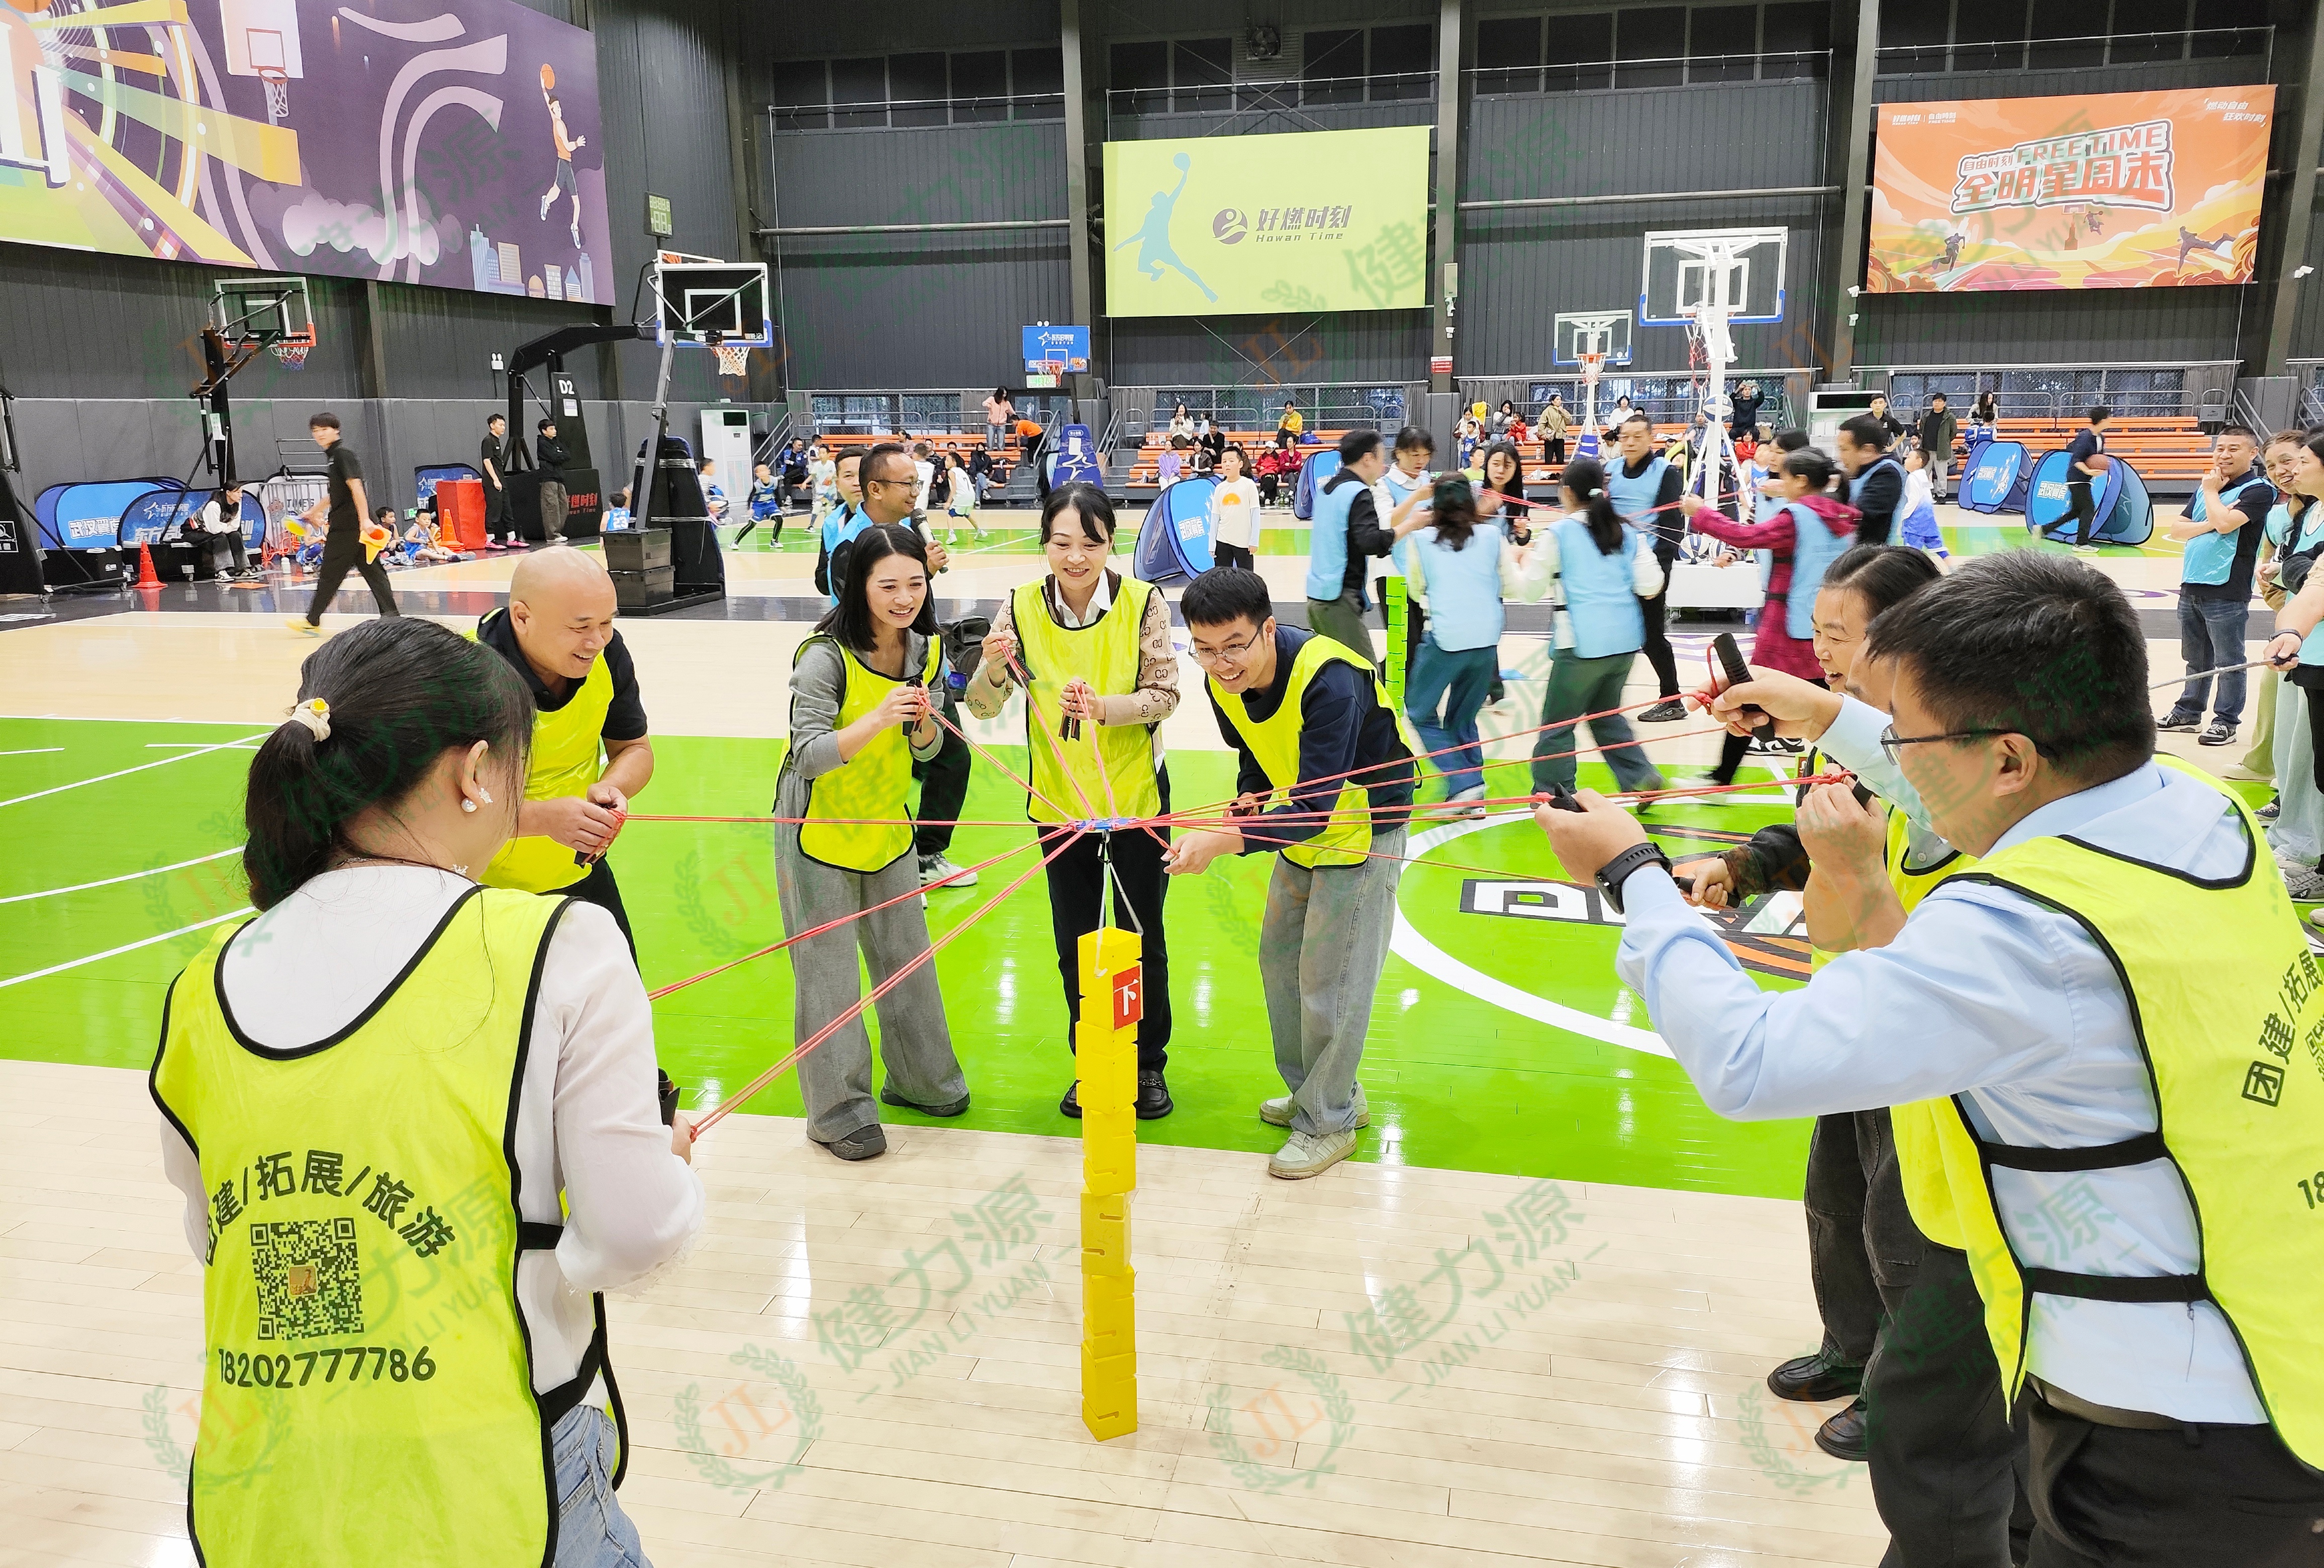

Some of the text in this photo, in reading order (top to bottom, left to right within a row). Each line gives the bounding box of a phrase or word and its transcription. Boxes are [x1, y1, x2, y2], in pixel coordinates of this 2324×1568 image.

[1964, 155, 2013, 171] 自由时刻
[1956, 151, 2165, 207] 全明星周末
[1256, 205, 1352, 231] 好燃时刻
[1256, 232, 1343, 242] Howan Time
[559, 380, 574, 395] D2
[613, 517, 627, 528] 23
[1114, 979, 1139, 1016] 下
[219, 1345, 436, 1388] 18202777786
